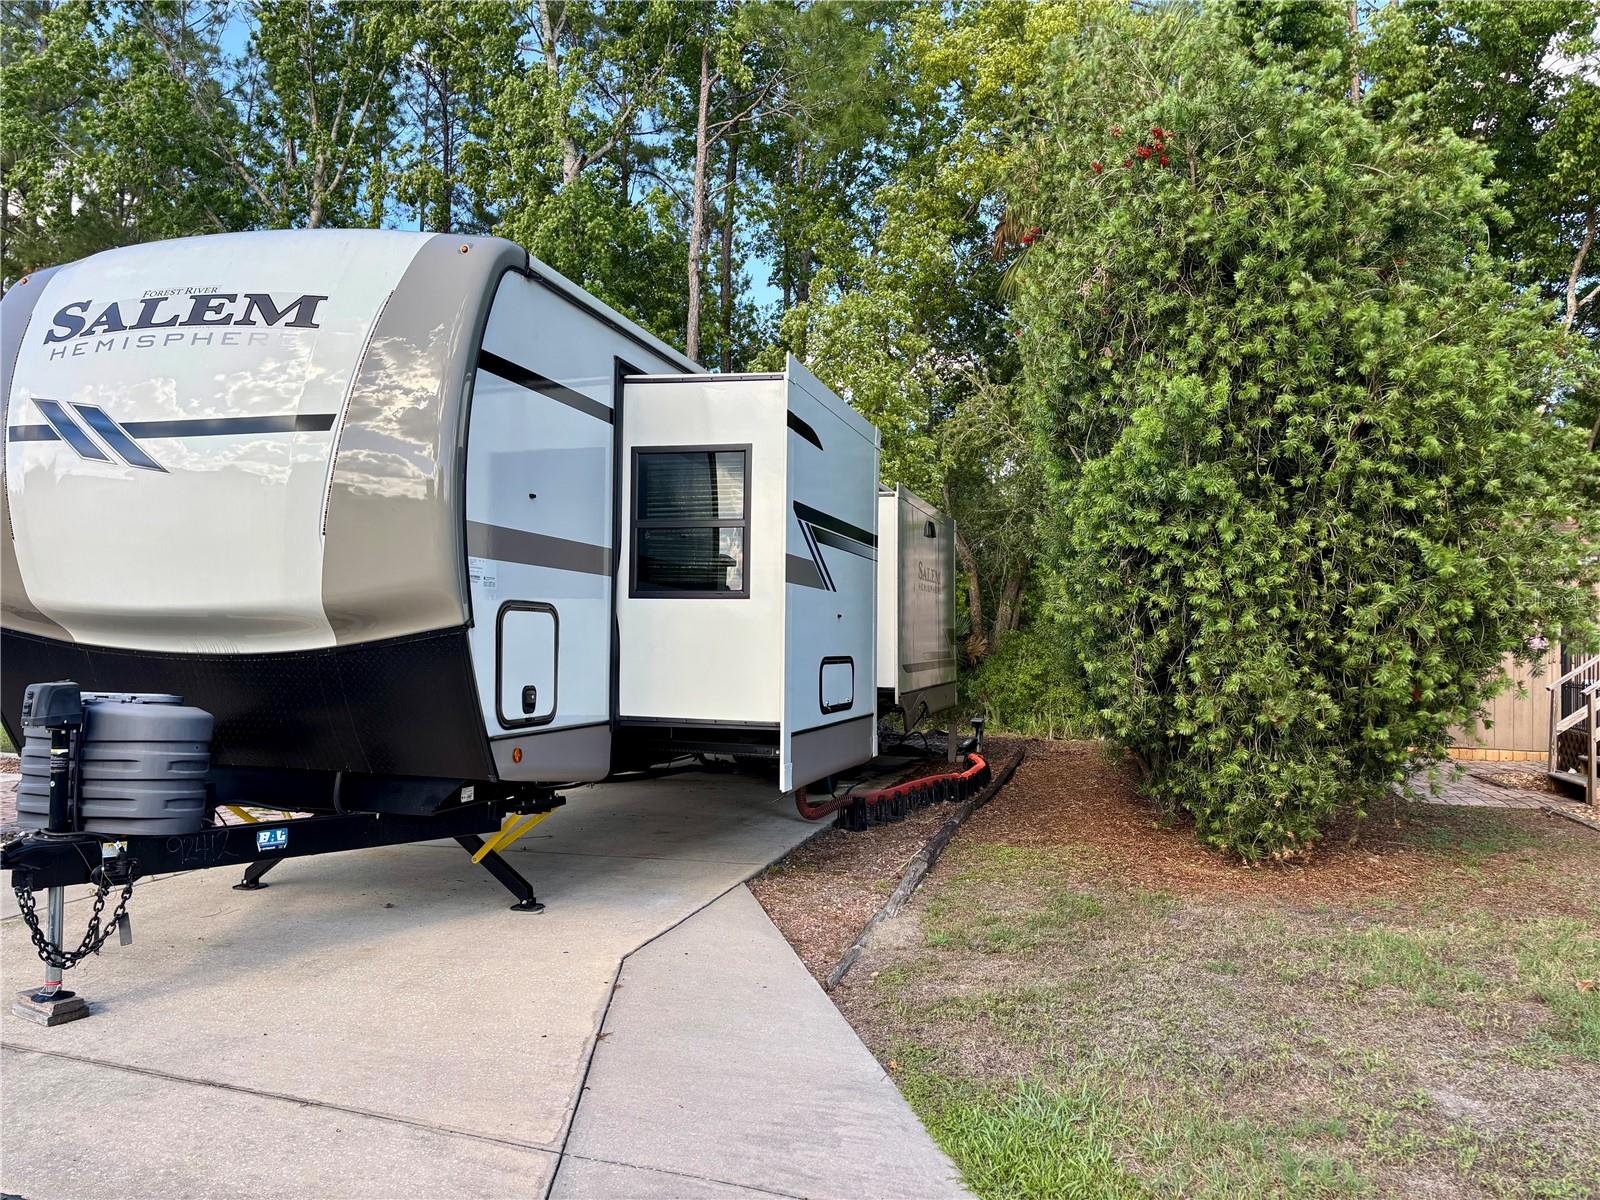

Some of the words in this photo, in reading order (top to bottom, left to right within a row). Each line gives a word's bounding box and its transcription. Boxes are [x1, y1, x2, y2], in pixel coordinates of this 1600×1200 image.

[143, 288, 183, 298] FOREST
[185, 287, 218, 295] RIVER
[43, 293, 328, 344] SALEM
[49, 332, 298, 360] HEMISPHERE
[918, 560, 941, 584] SALEM
